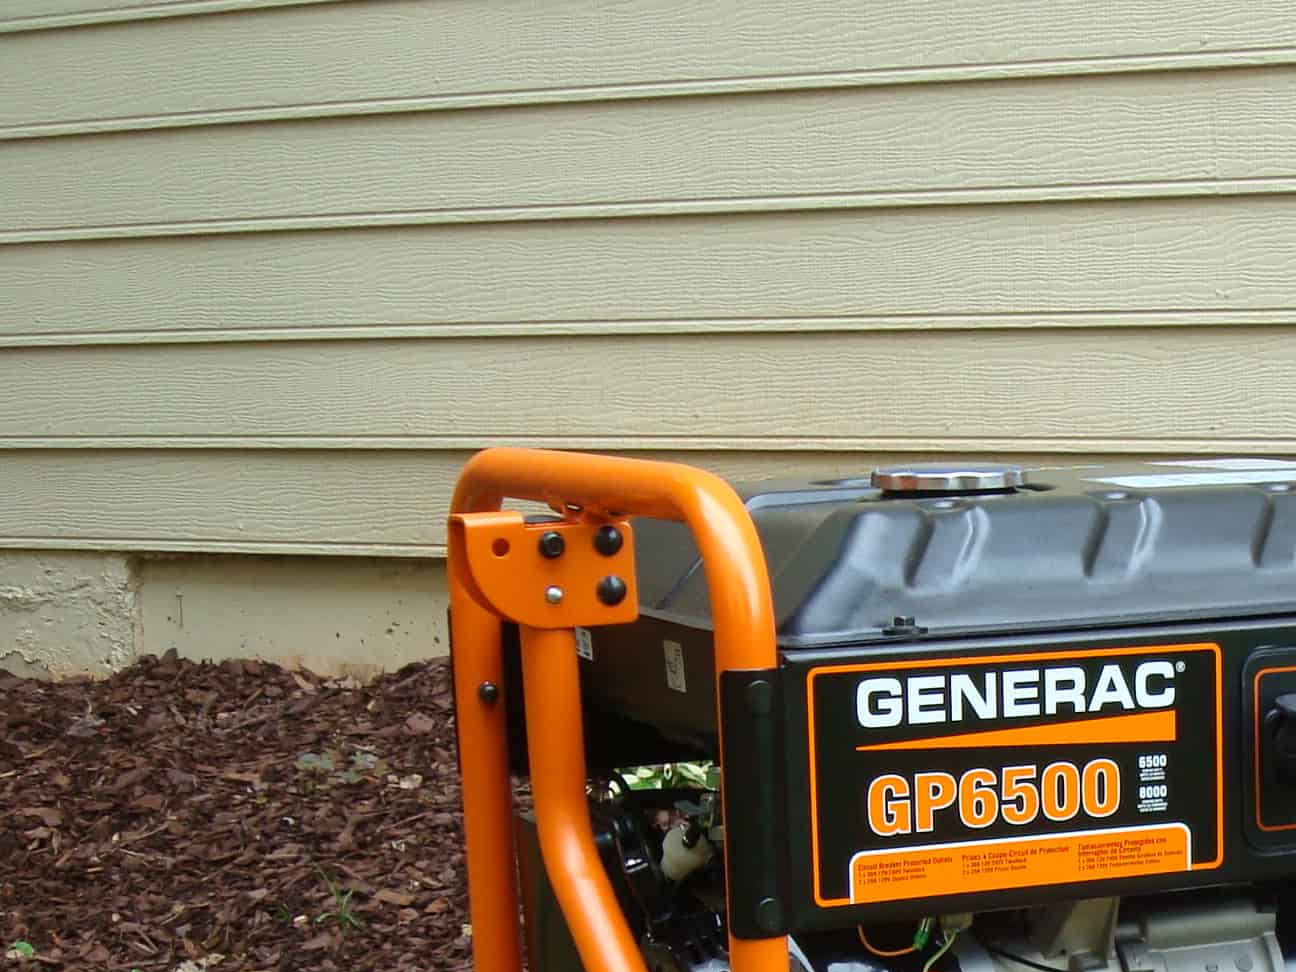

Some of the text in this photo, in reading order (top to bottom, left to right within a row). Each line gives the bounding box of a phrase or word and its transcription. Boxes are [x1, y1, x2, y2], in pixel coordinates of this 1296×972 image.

[856, 660, 1176, 728] GENERAC
[1138, 754, 1167, 768] 6500
[867, 758, 1121, 837] GP6500
[1139, 785, 1168, 799] 8000
